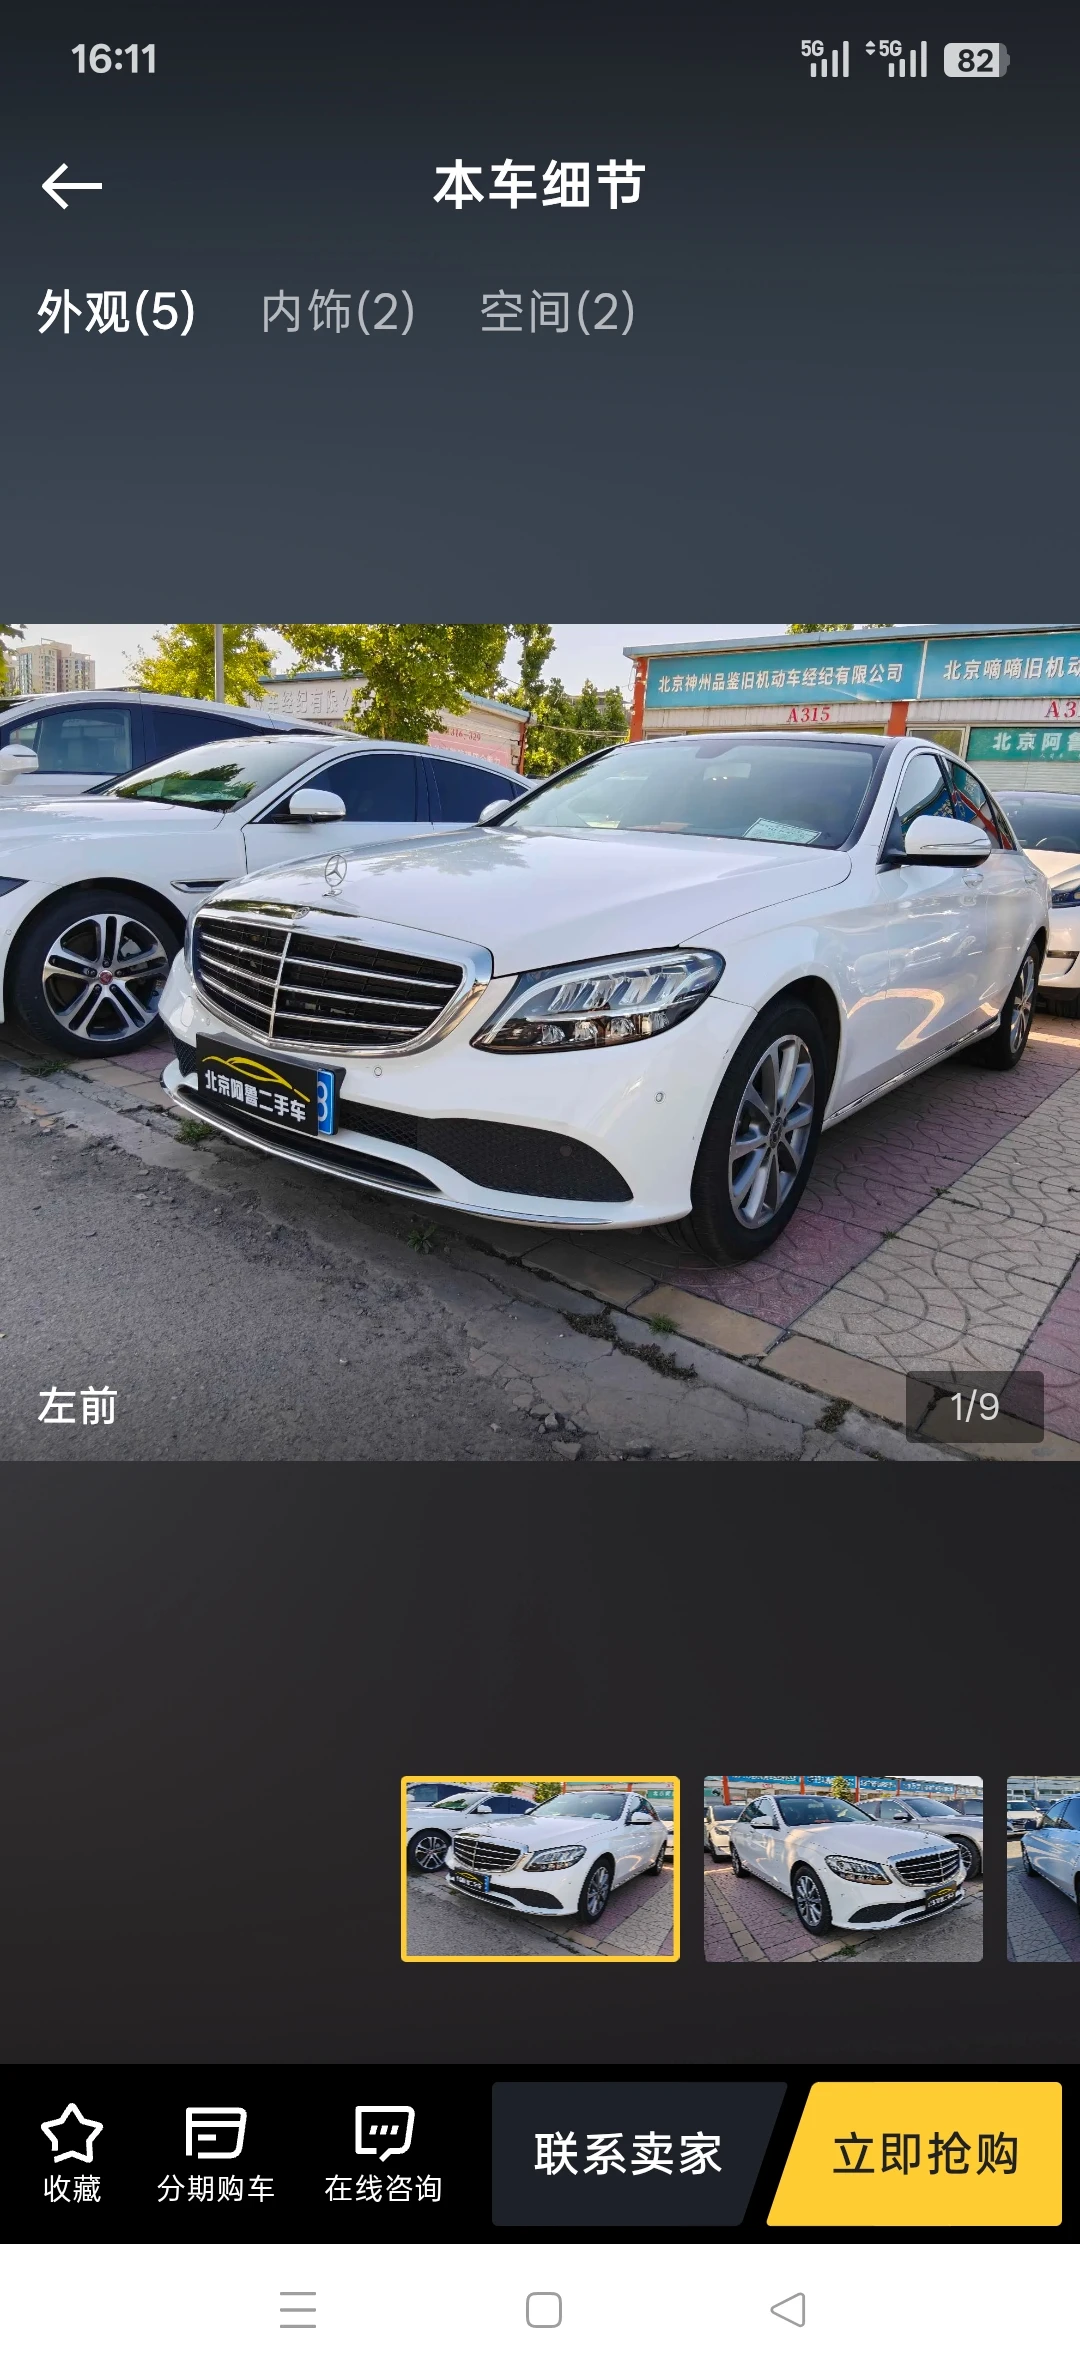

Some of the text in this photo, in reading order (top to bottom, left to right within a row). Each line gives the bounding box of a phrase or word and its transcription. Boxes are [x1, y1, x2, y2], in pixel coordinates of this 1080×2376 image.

[71, 43, 156, 74] 16:11
[801, 40, 825, 57] 5G
[879, 40, 903, 57] 5G
[957, 48, 994, 73] 82
[432, 158, 646, 210] 本车细节
[36, 289, 195, 337] 外观(5)
[262, 289, 415, 336] 内饰(2)
[480, 289, 635, 336] 空间(2)
[658, 663, 903, 693] 北京神州品鉴旧机动车经纪有限公司
[786, 706, 831, 723] A315
[1044, 700, 1080, 718] A3
[204, 1069, 307, 1122] 北京阿鲁二手车
[533, 2130, 723, 2176] 联系卖家
[832, 2130, 1018, 2176] 立即抢购
[43, 2174, 102, 2203] 收藏
[156, 2174, 275, 2203] 分期购车
[324, 2174, 442, 2203] 在线咨询
